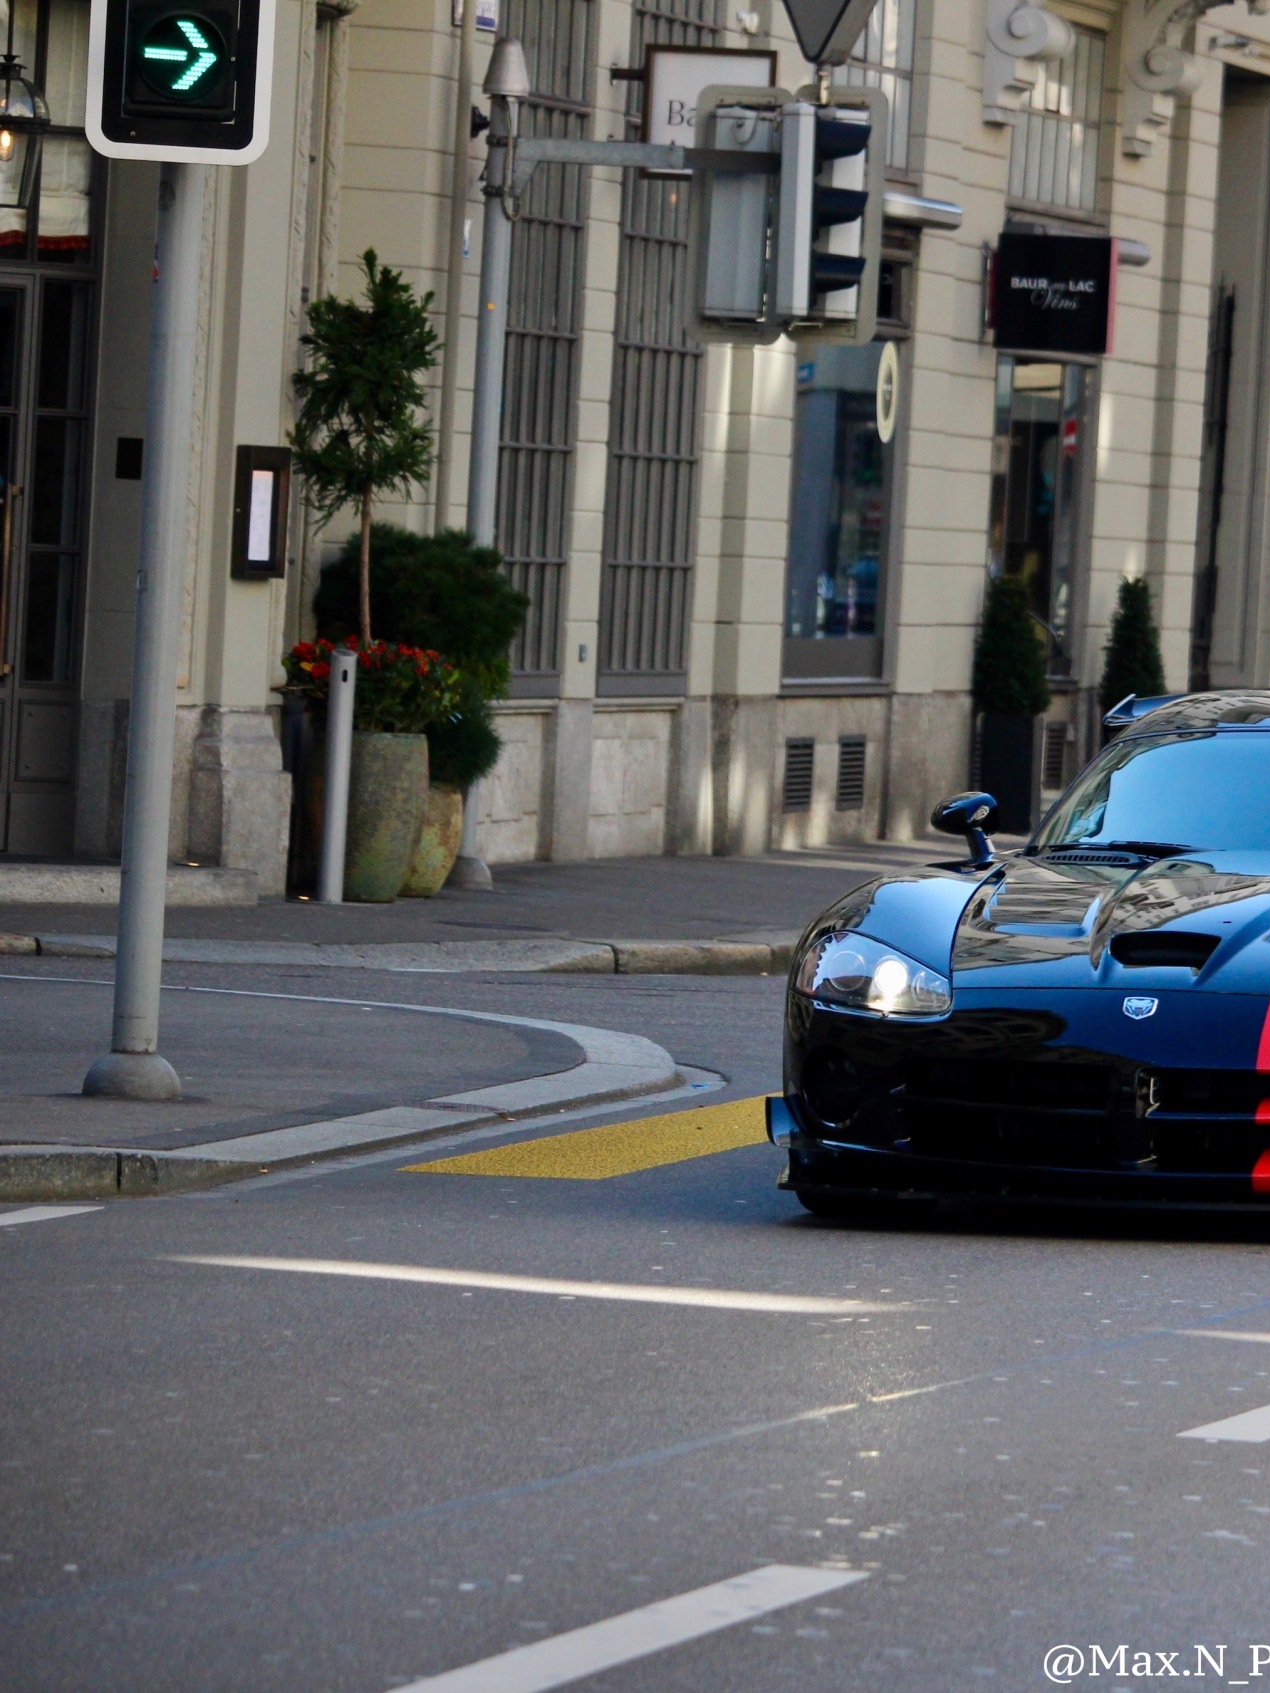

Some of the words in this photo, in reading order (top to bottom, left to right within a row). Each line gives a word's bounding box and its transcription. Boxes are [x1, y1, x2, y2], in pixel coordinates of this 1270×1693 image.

[667, 100, 697, 128] Ba
[1010, 277, 1048, 289] BAUR
[1069, 280, 1096, 292] LAC
